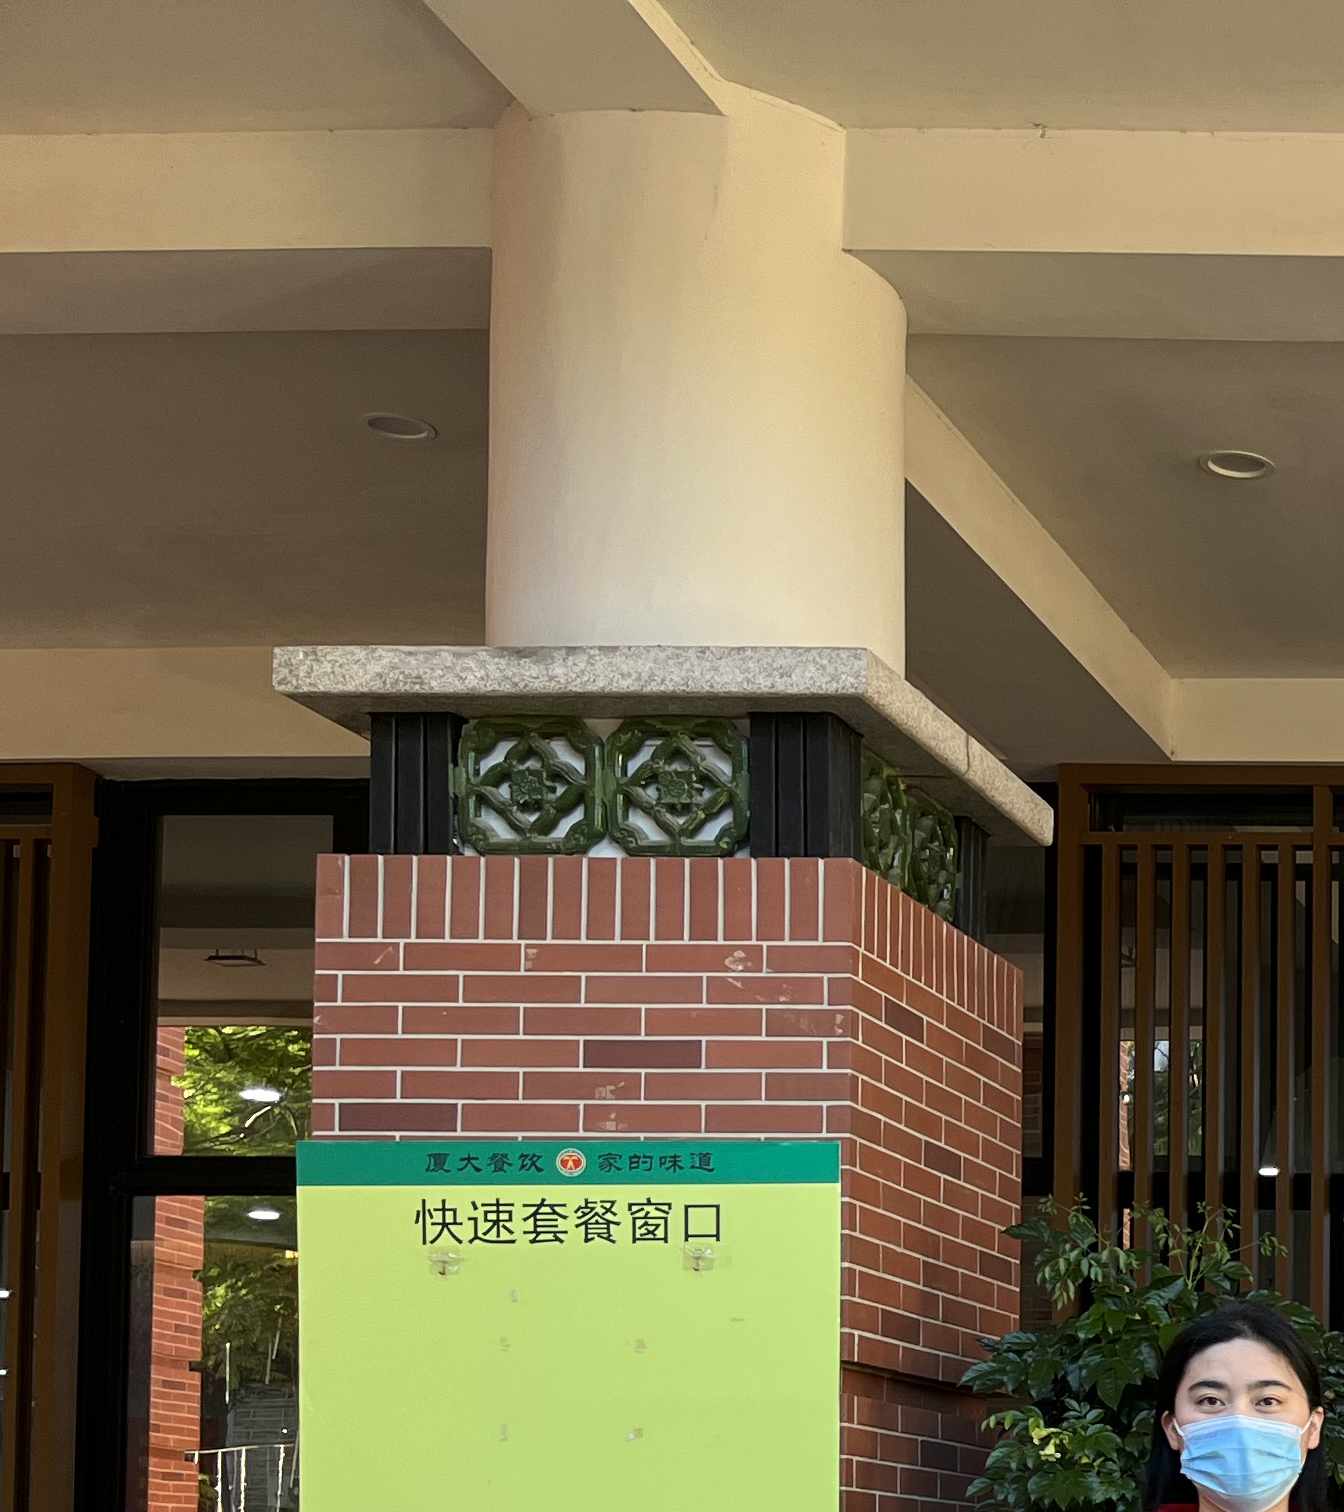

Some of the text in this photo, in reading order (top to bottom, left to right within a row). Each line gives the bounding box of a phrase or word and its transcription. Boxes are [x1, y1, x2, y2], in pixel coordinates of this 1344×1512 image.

[425, 1152, 716, 1174] 厦大餐饮 家的味道
[414, 1197, 721, 1246] 快速套餐窗口
